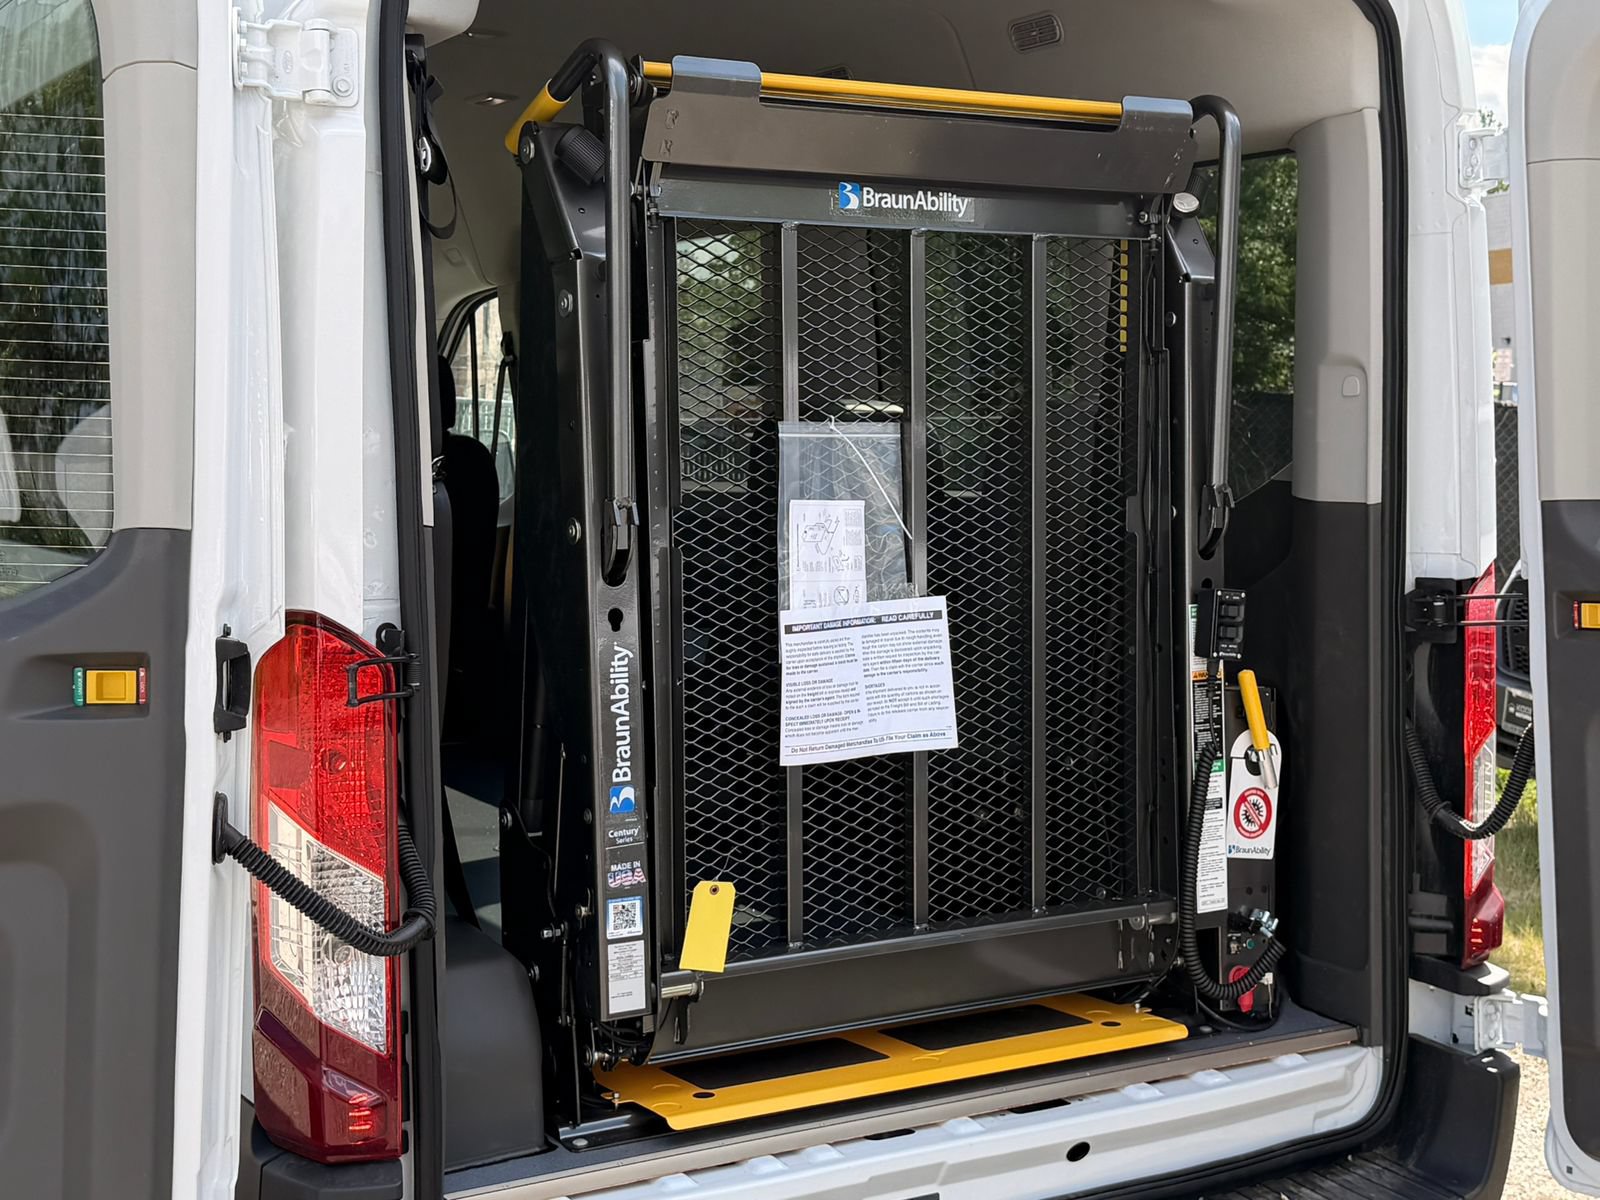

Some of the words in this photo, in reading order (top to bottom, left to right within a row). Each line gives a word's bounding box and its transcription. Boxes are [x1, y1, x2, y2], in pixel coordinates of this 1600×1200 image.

[863, 187, 968, 218] BraunAbility
[792, 623, 823, 632] IMPORTANT
[898, 612, 934, 621] CAREFULLY
[610, 644, 634, 783] BraunAbility
[608, 828, 639, 838] Century
[1236, 846, 1272, 856] BraunAbility
[611, 862, 632, 872] MADE
[633, 861, 641, 869] IN
[608, 867, 647, 888] USA
